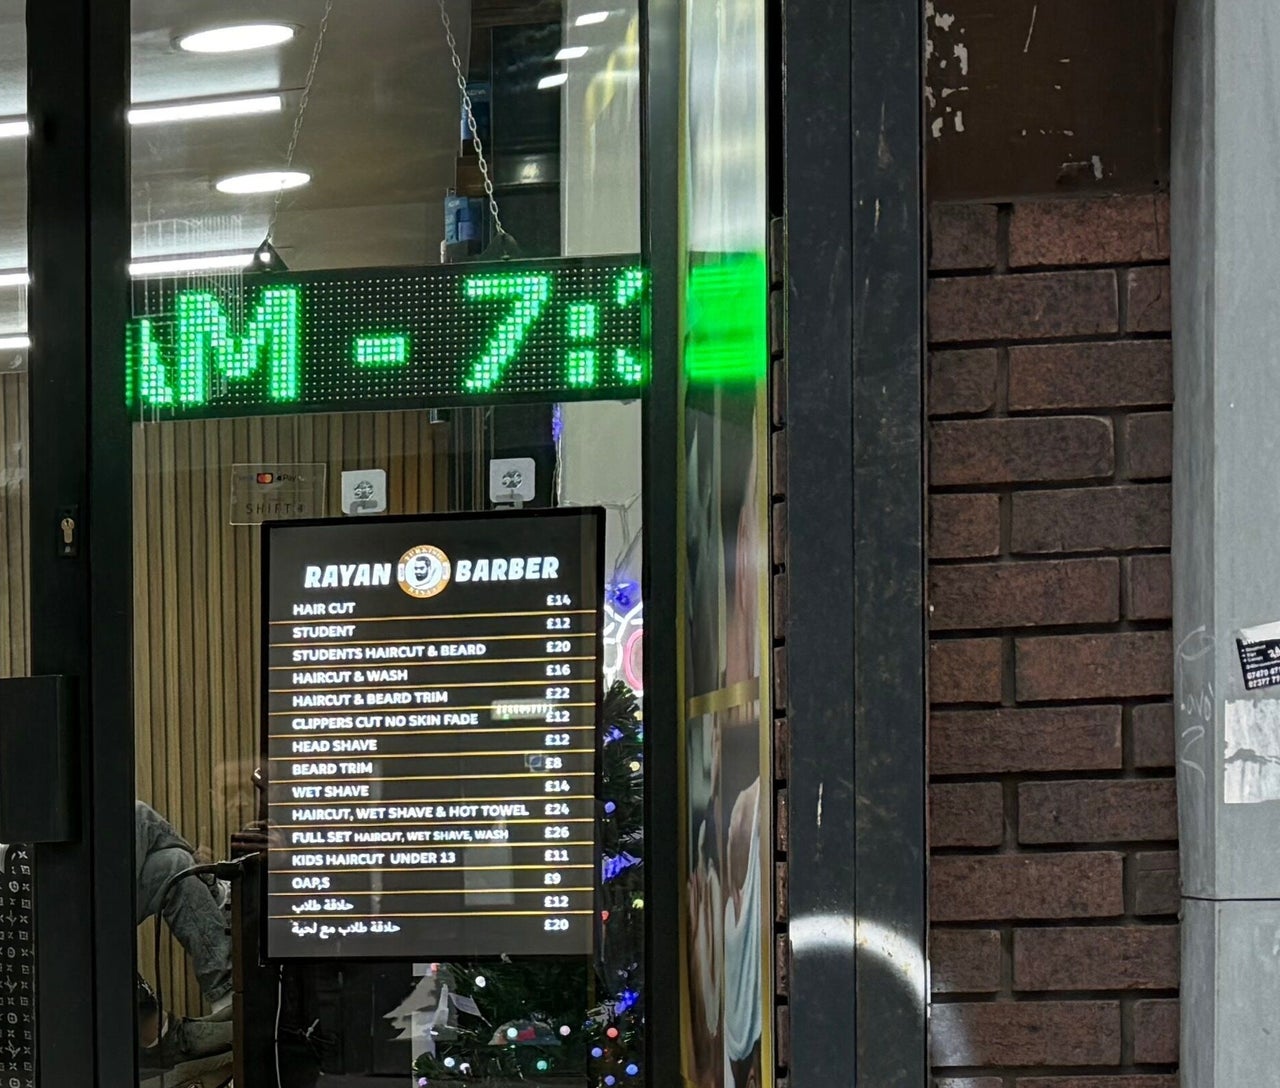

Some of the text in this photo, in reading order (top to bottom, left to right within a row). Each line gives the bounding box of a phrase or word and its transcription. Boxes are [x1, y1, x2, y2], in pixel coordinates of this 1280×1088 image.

[126, 285, 301, 406] M
[304, 563, 392, 588] RAYAN
[454, 556, 560, 582] BARBER
[293, 594, 572, 615] HAIR CUT £14
[293, 617, 571, 638] STUDENT £12
[293, 641, 571, 661] STUDENTS HAIRCUT & BEARD £20
[293, 664, 571, 684] HAIRCUT & WASH £16
[293, 687, 570, 707] HAIRCUT & BEARD TRIM £22
[292, 717, 353, 730] CLIPPERS
[355, 716, 383, 728] CUT
[385, 715, 406, 727] NO
[409, 714, 441, 726] SKIN
[443, 713, 479, 725] FADE
[545, 710, 570, 722] £12
[292, 734, 570, 753] HEAD SHAVE £12
[292, 757, 563, 775] BEARD TRIM £8
[292, 780, 570, 798] WET SHAVE £14
[292, 803, 570, 822] HAIRCUT, WET SHAVE & HOT TOWEL £24
[292, 826, 570, 844] FULL SET HAIRCUT, WET SHAVE, WASH £26
[292, 850, 569, 866] KIDS HAIRCUT UNDER 13 £11
[544, 872, 561, 885] £9
[291, 899, 354, 914] حلاقة طلاب
[544, 895, 569, 908] £12
[319, 925, 336, 939] مع
[338, 921, 368, 936] طلاب
[370, 920, 401, 933] حلاقة
[544, 918, 570, 931] £20
